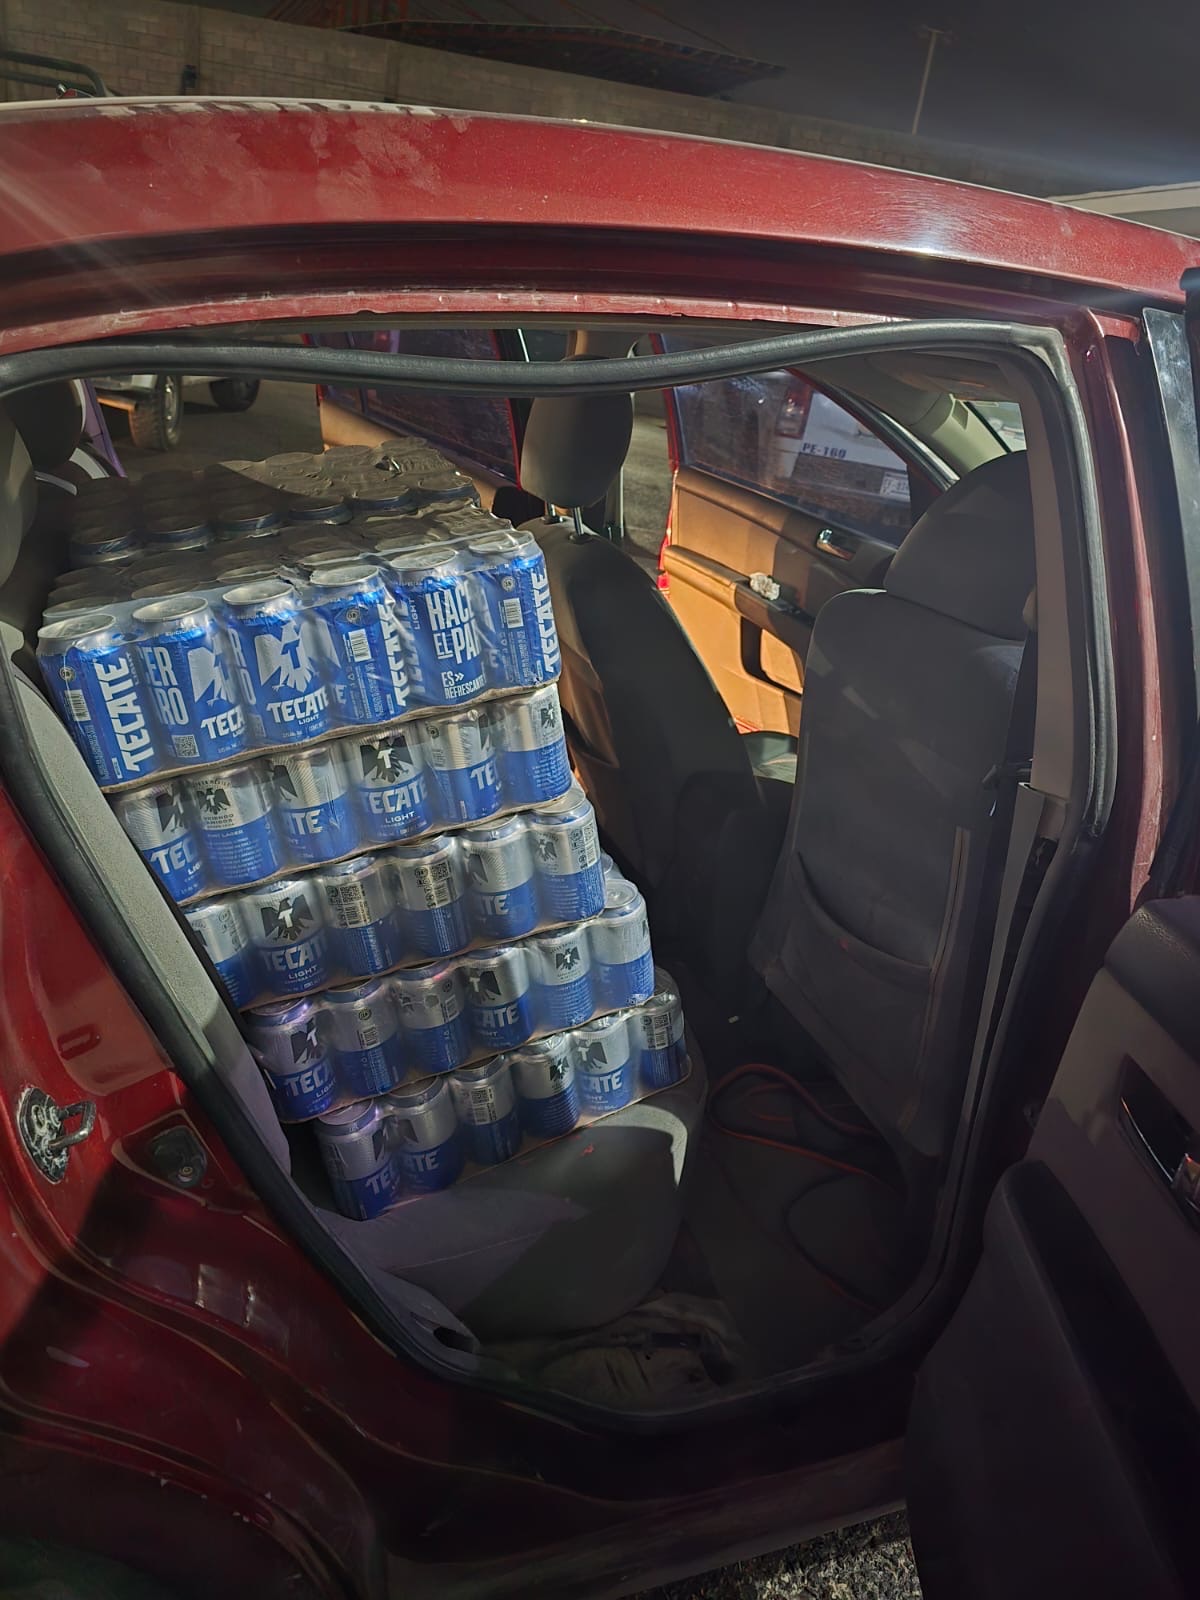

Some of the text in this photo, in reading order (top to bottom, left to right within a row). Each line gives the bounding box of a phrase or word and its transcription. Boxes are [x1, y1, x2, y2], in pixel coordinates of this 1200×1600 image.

[408, 598, 421, 630] LIGHT
[531, 567, 562, 673] TECATE
[433, 633, 454, 656] EL
[441, 670, 455, 688] ES
[94, 657, 155, 772] TECATE
[298, 715, 320, 725] LIGHT
[385, 811, 415, 824] LIGHT
[288, 965, 318, 980] LIGHT
